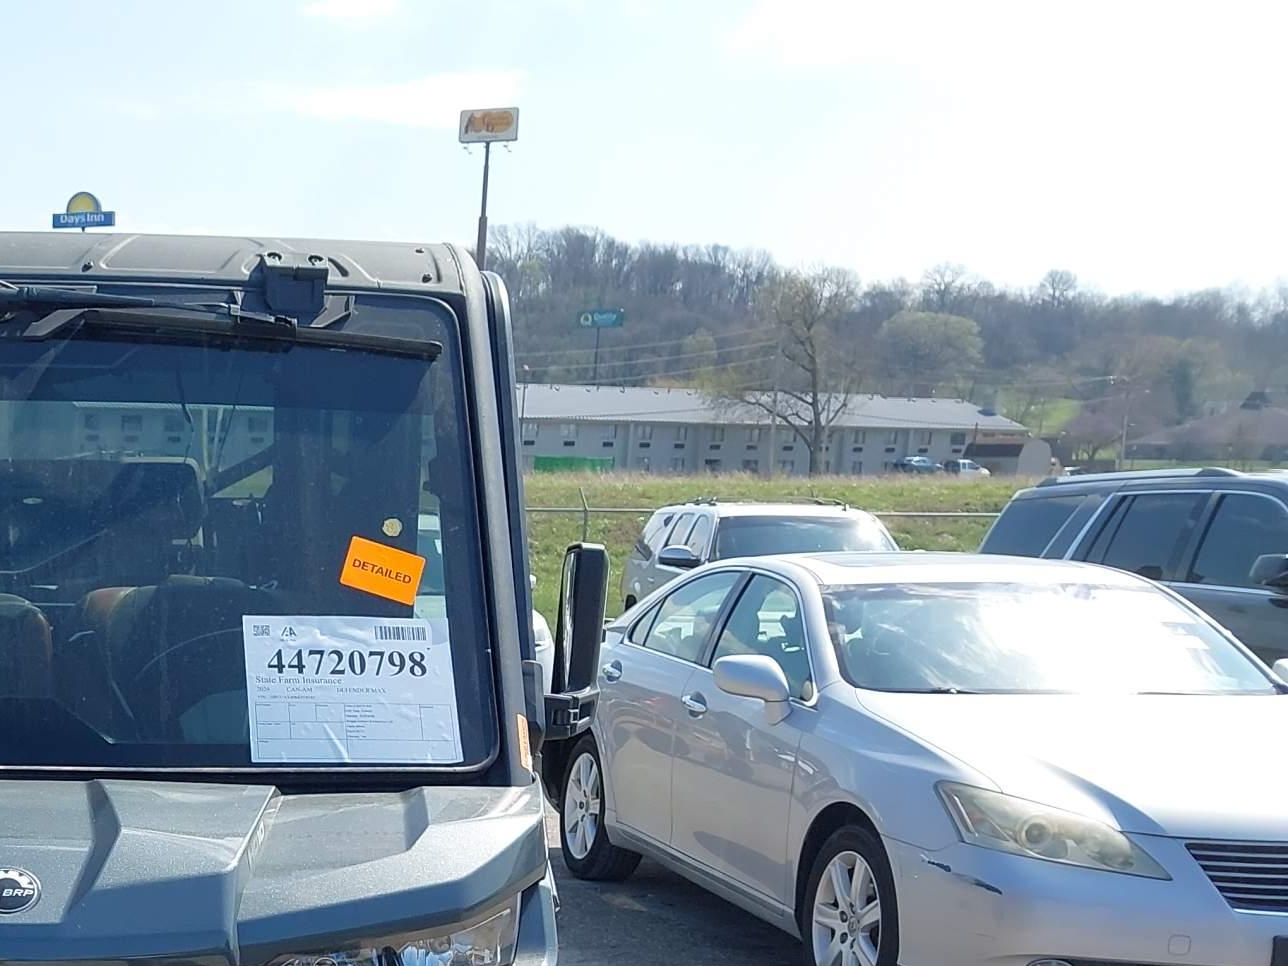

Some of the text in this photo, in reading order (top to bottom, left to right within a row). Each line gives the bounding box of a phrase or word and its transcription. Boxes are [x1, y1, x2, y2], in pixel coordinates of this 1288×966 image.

[60, 213, 105, 225] Days Inn
[352, 559, 412, 584] DETAILED
[267, 648, 427, 677] 44720798
[255, 676, 342, 685] State Farm Insurance
[2, 888, 34, 897] BRP
